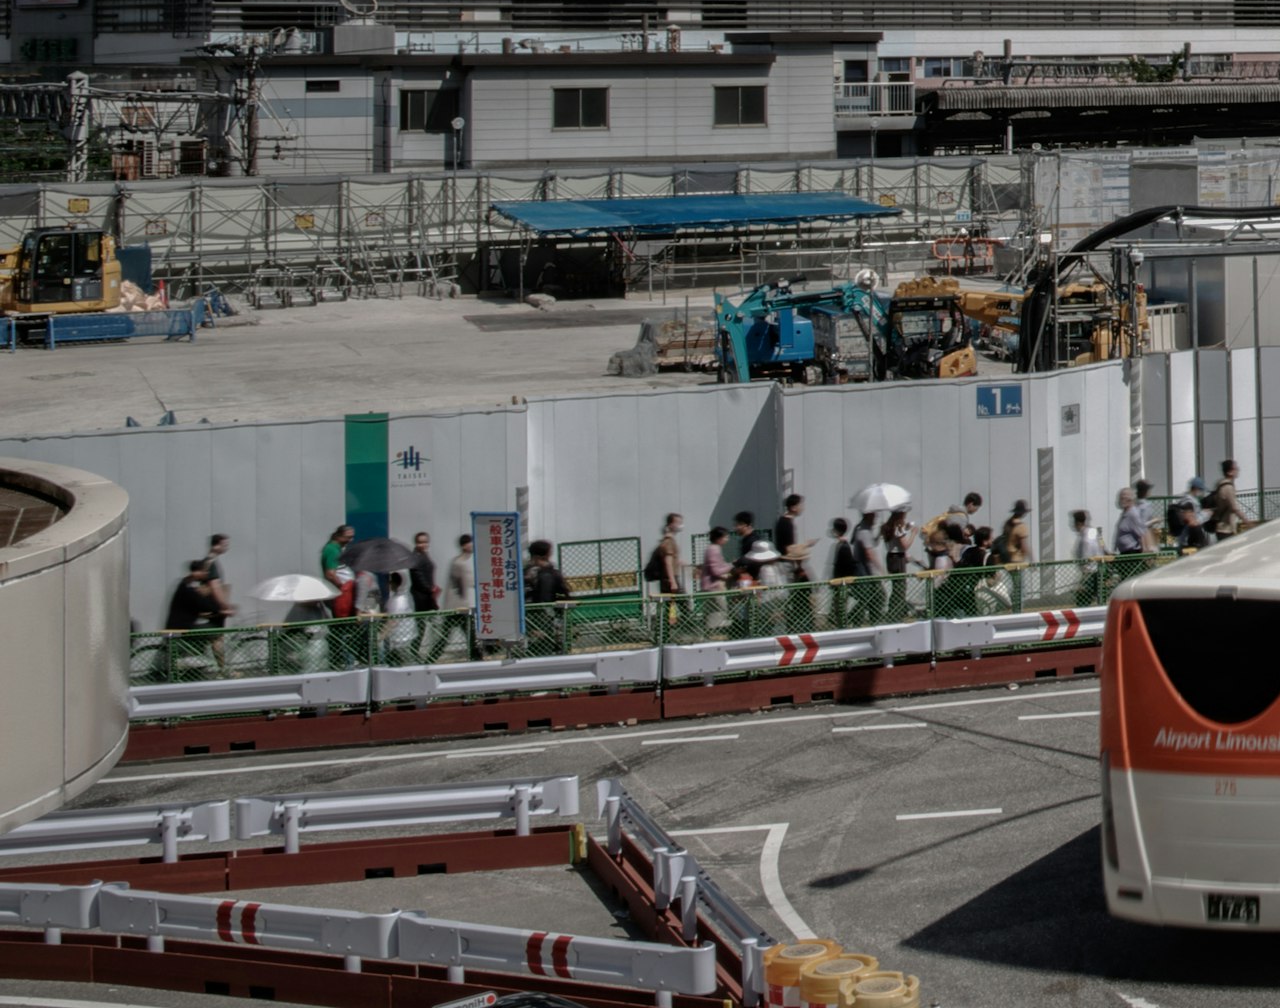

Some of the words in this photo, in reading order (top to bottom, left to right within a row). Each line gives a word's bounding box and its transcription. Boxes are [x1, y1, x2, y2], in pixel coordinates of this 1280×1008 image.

[991, 387, 1002, 415] 1
[489, 519, 505, 600] 一般車の駐停車は
[503, 517, 517, 592] タクシーおりば
[479, 582, 494, 634] できません
[1153, 725, 1212, 752] Airport
